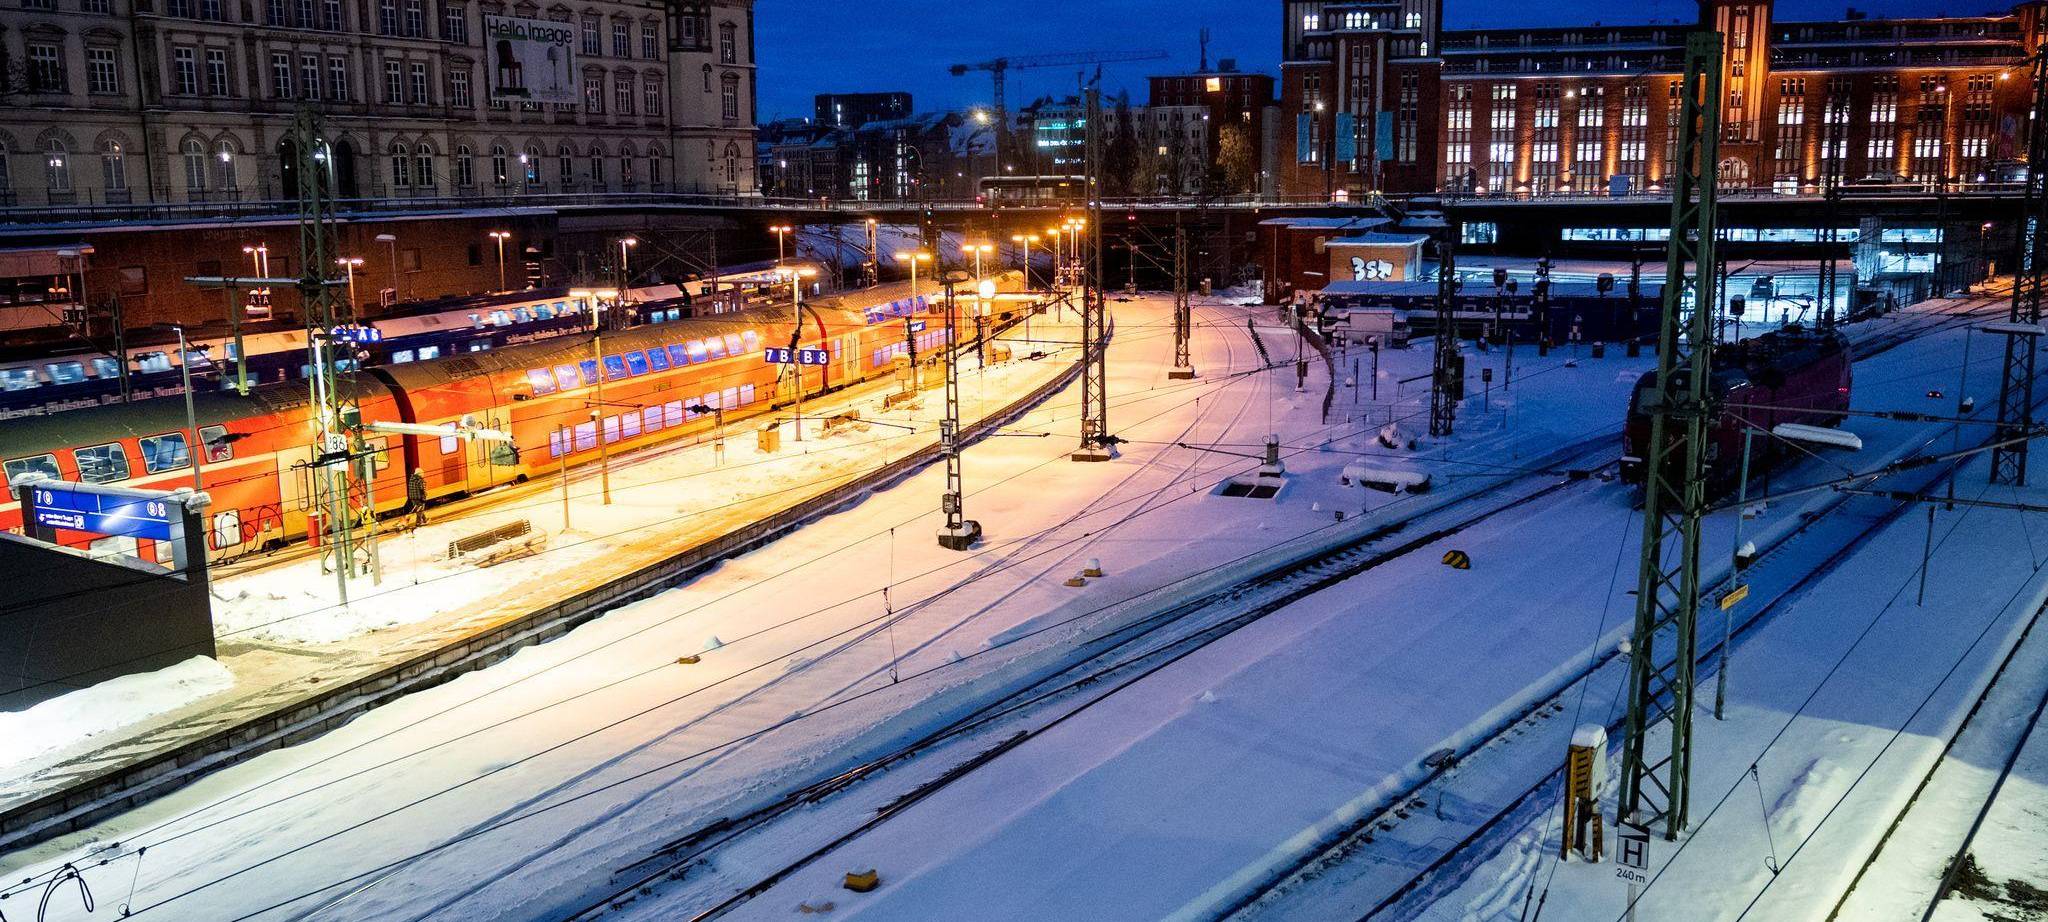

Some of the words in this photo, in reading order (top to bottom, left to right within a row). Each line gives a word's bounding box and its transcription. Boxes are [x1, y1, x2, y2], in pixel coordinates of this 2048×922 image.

[488, 18, 525, 38] Hello
[528, 21, 572, 47] Image
[359, 327, 368, 341] A
[766, 349, 773, 361] 7
[780, 350, 788, 362] B
[804, 351, 812, 363] B
[819, 352, 827, 363] 8
[941, 427, 951, 443] H
[35, 490, 42, 504] 7
[158, 502, 166, 518] 8
[1624, 839, 1643, 866] H
[1616, 868, 1634, 880] 240
[1635, 875, 1645, 883] m
